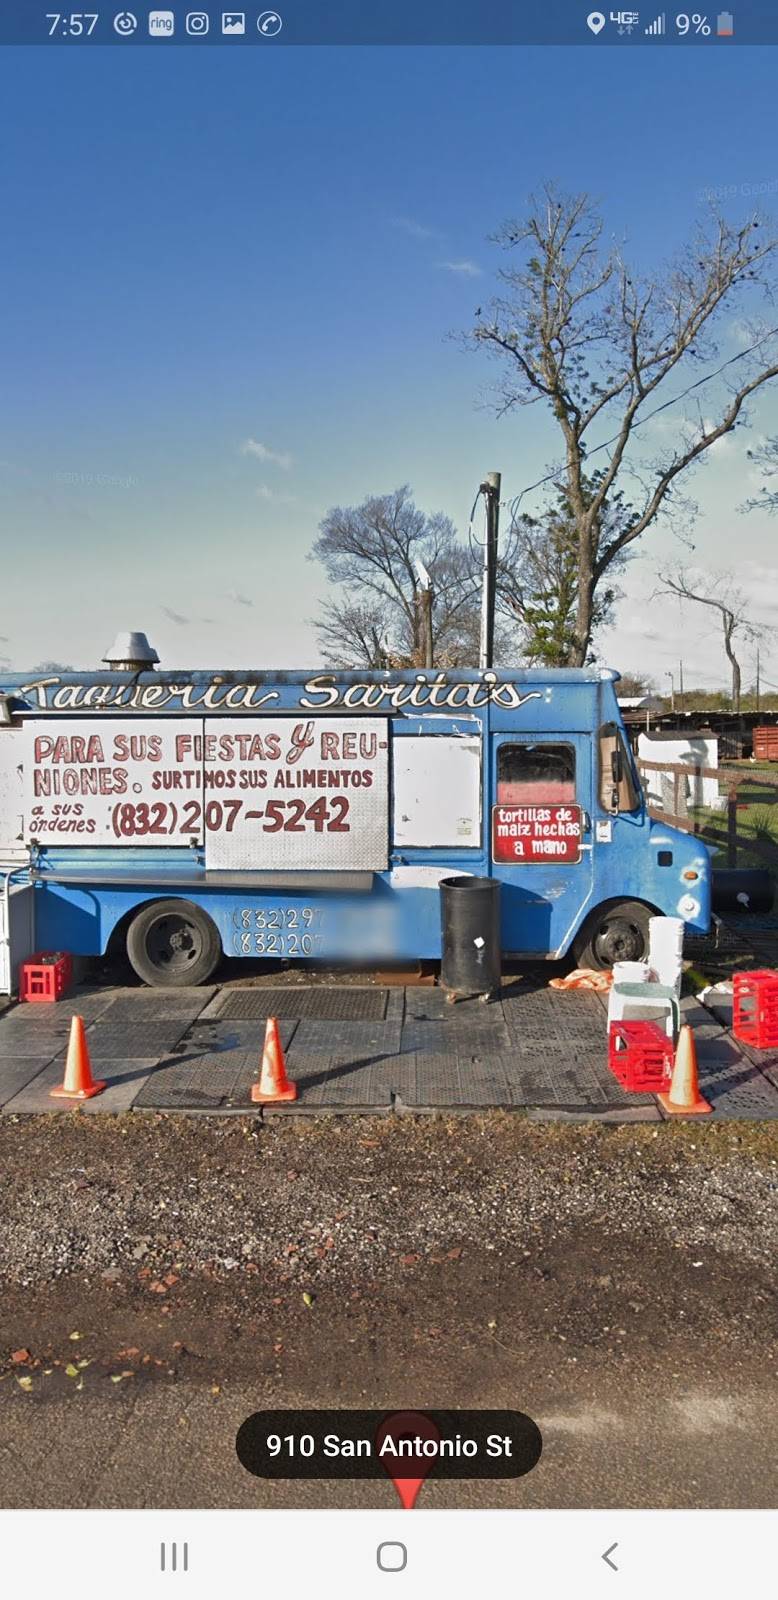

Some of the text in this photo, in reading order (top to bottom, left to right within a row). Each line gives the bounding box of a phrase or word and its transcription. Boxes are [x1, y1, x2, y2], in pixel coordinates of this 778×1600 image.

[19, 672, 542, 710] Taqueria Sarita's
[34, 734, 104, 764] PARA
[113, 734, 162, 762] SUS
[175, 733, 282, 762] FIESTAS
[320, 732, 388, 760] REU-
[152, 771, 237, 790] SURTIMOS
[239, 770, 268, 789] SUS
[274, 770, 373, 789] ALIMENTOS
[31, 802, 84, 816] a sus
[498, 808, 572, 822] tortillas de
[534, 822, 580, 836] hechas
[514, 840, 567, 855] a mano
